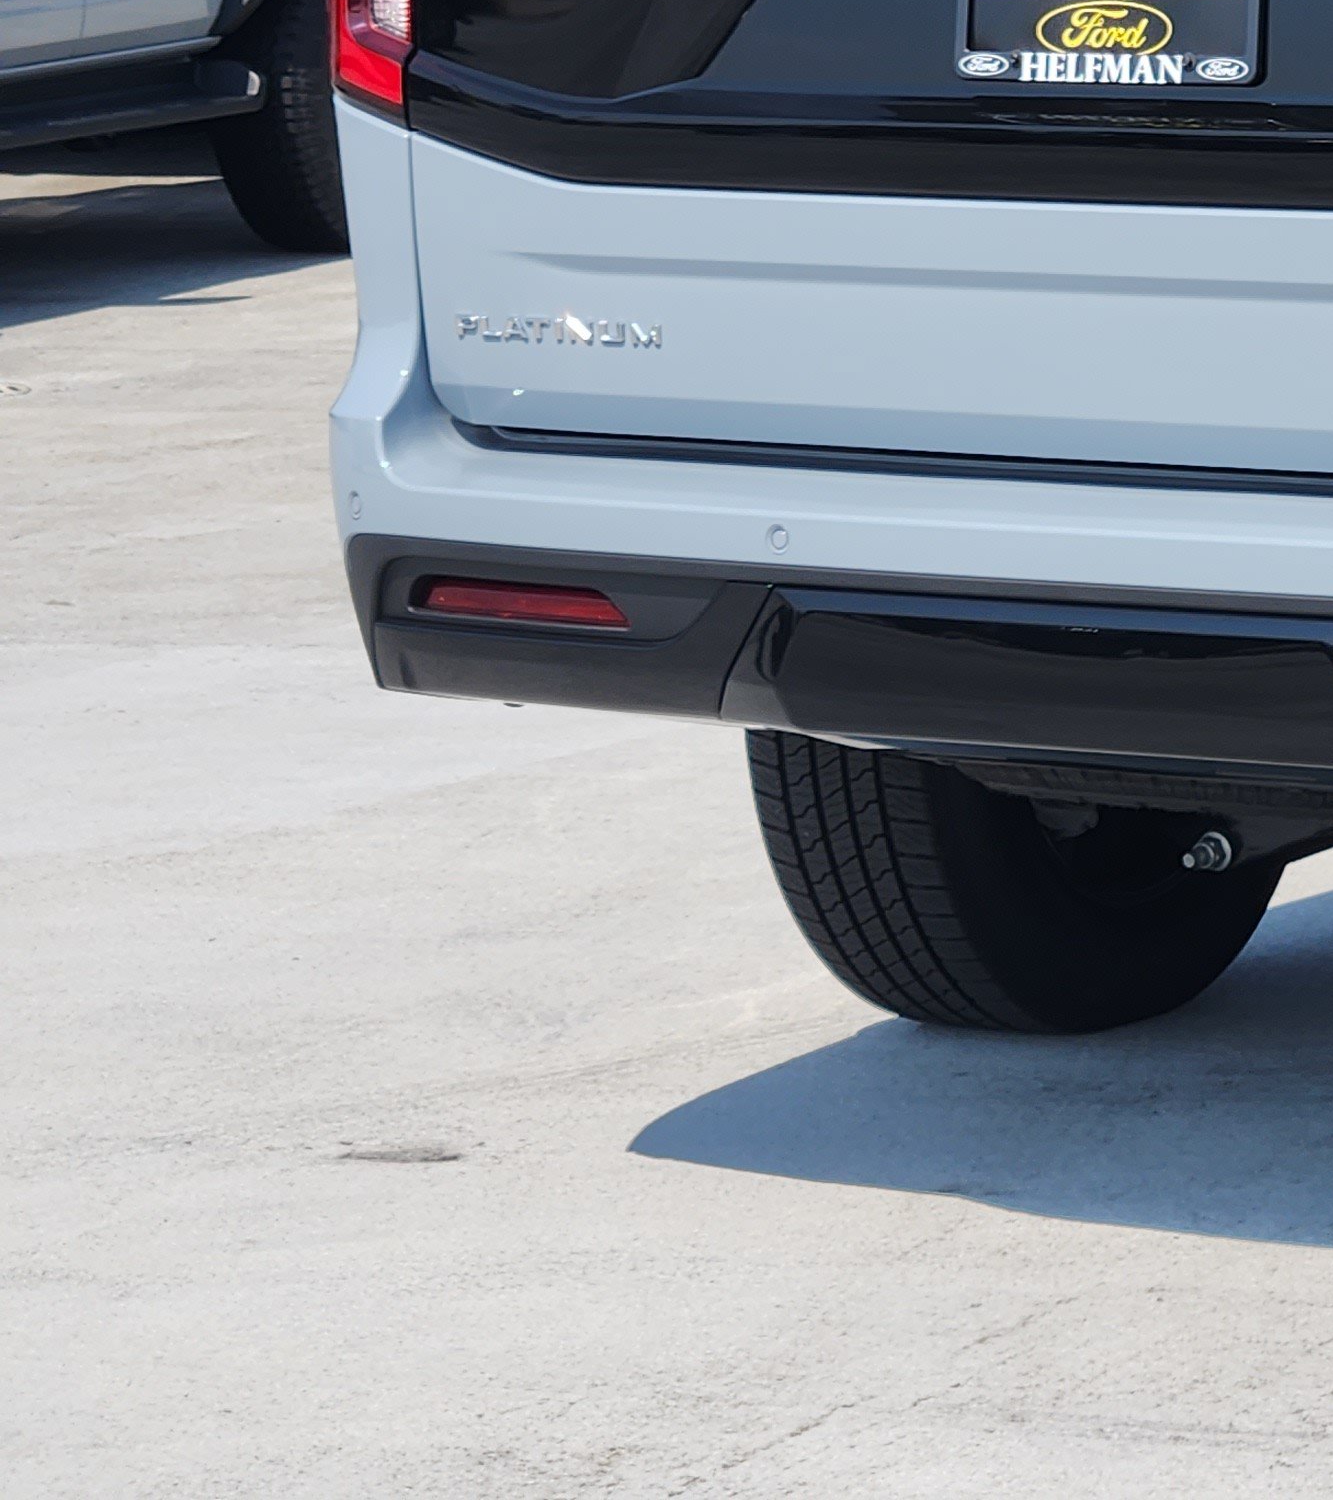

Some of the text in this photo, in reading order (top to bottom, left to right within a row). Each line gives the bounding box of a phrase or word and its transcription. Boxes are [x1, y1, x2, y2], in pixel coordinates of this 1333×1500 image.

[1060, 7, 1149, 49] Ford
[1018, 52, 1185, 85] HELFMAN
[455, 313, 662, 349] PLATINUM
